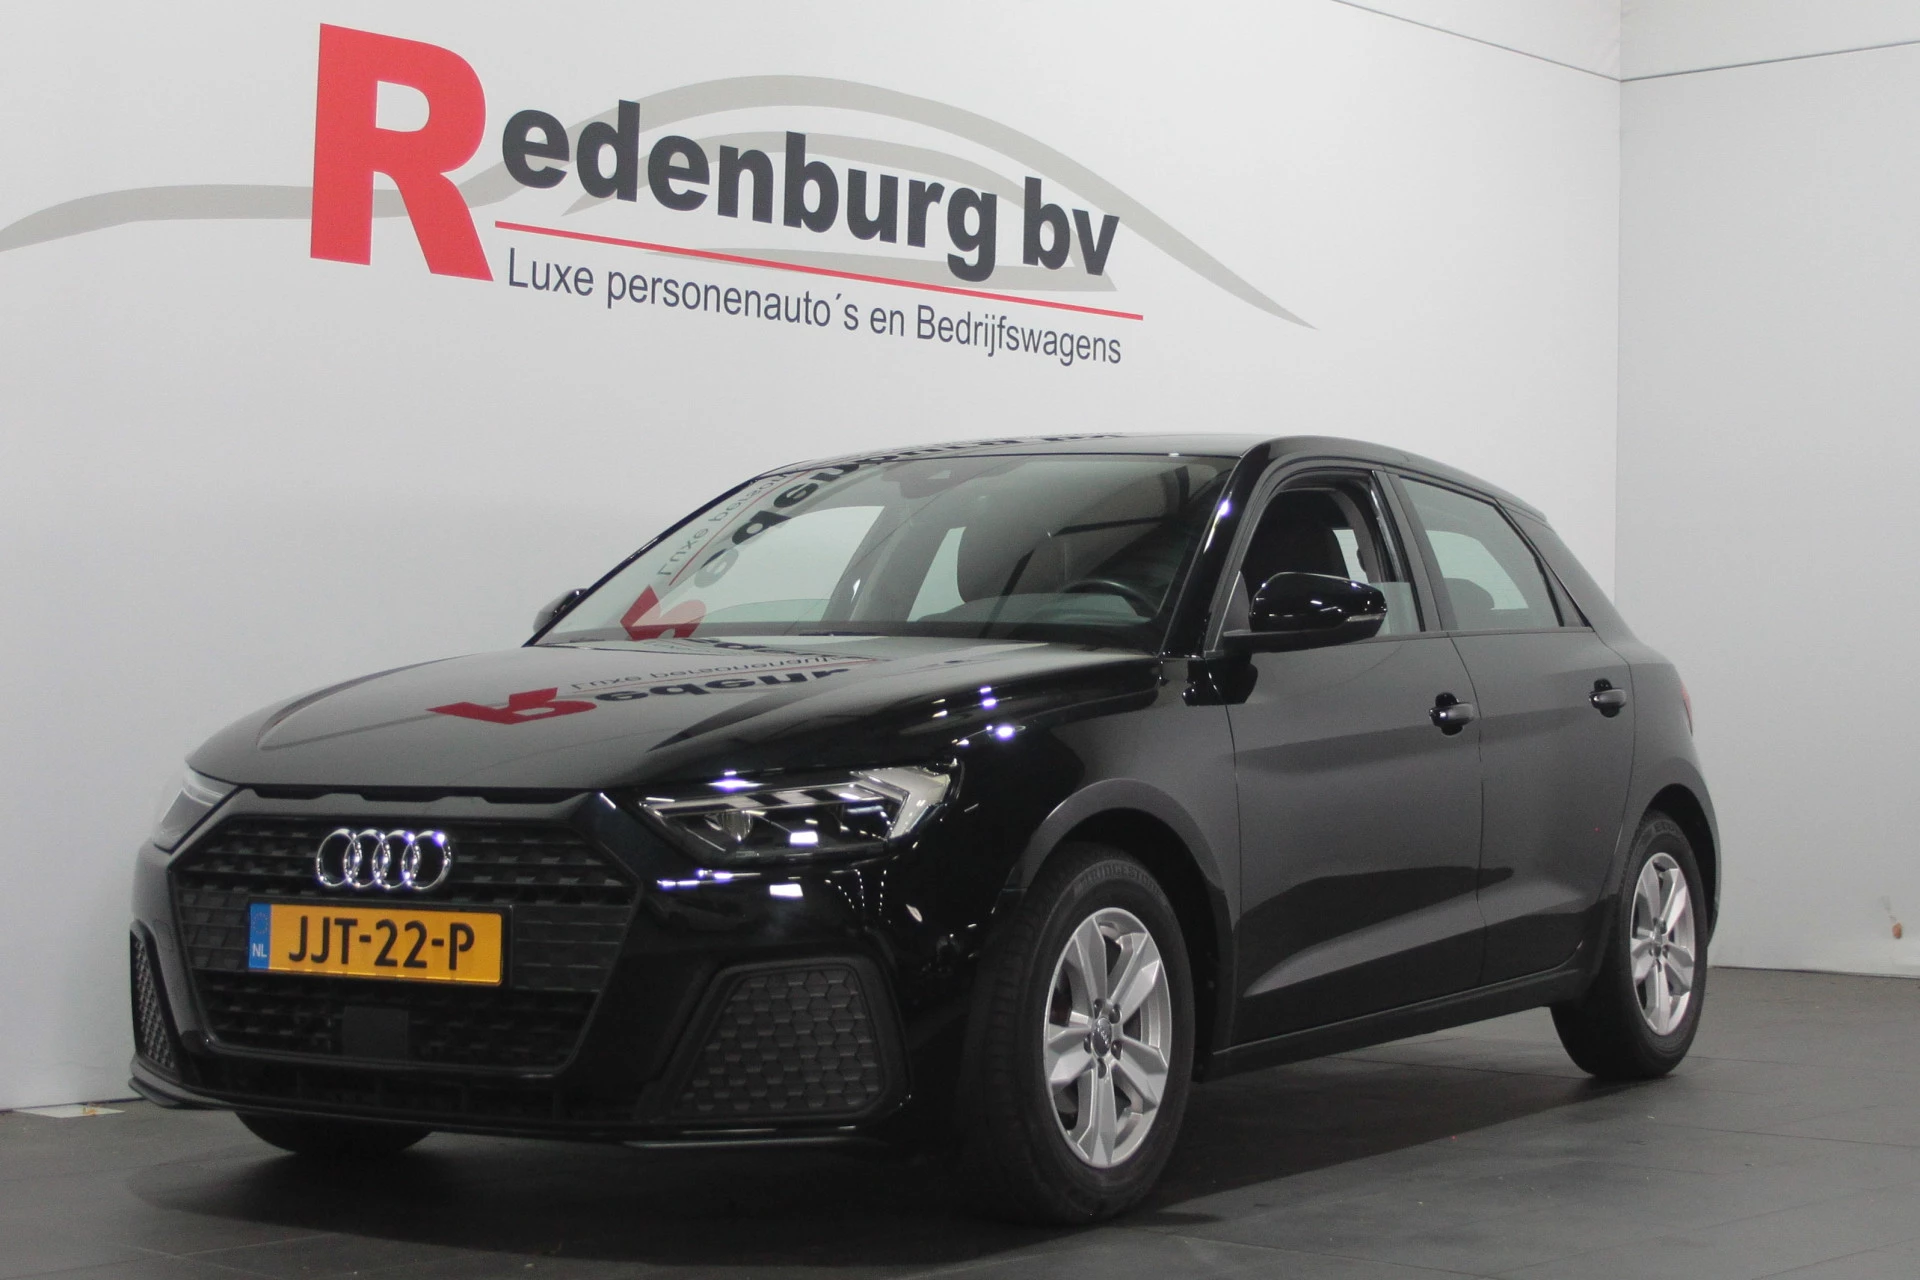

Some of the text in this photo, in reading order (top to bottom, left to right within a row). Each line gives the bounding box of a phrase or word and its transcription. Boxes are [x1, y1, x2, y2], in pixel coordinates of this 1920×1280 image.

[311, 24, 1119, 282] Redenburg bv
[509, 248, 594, 297] Luxe
[871, 308, 905, 337] en
[917, 305, 1121, 367] Bedrijfswagens
[252, 943, 268, 958] NL
[288, 915, 475, 971] JJT-22-P
